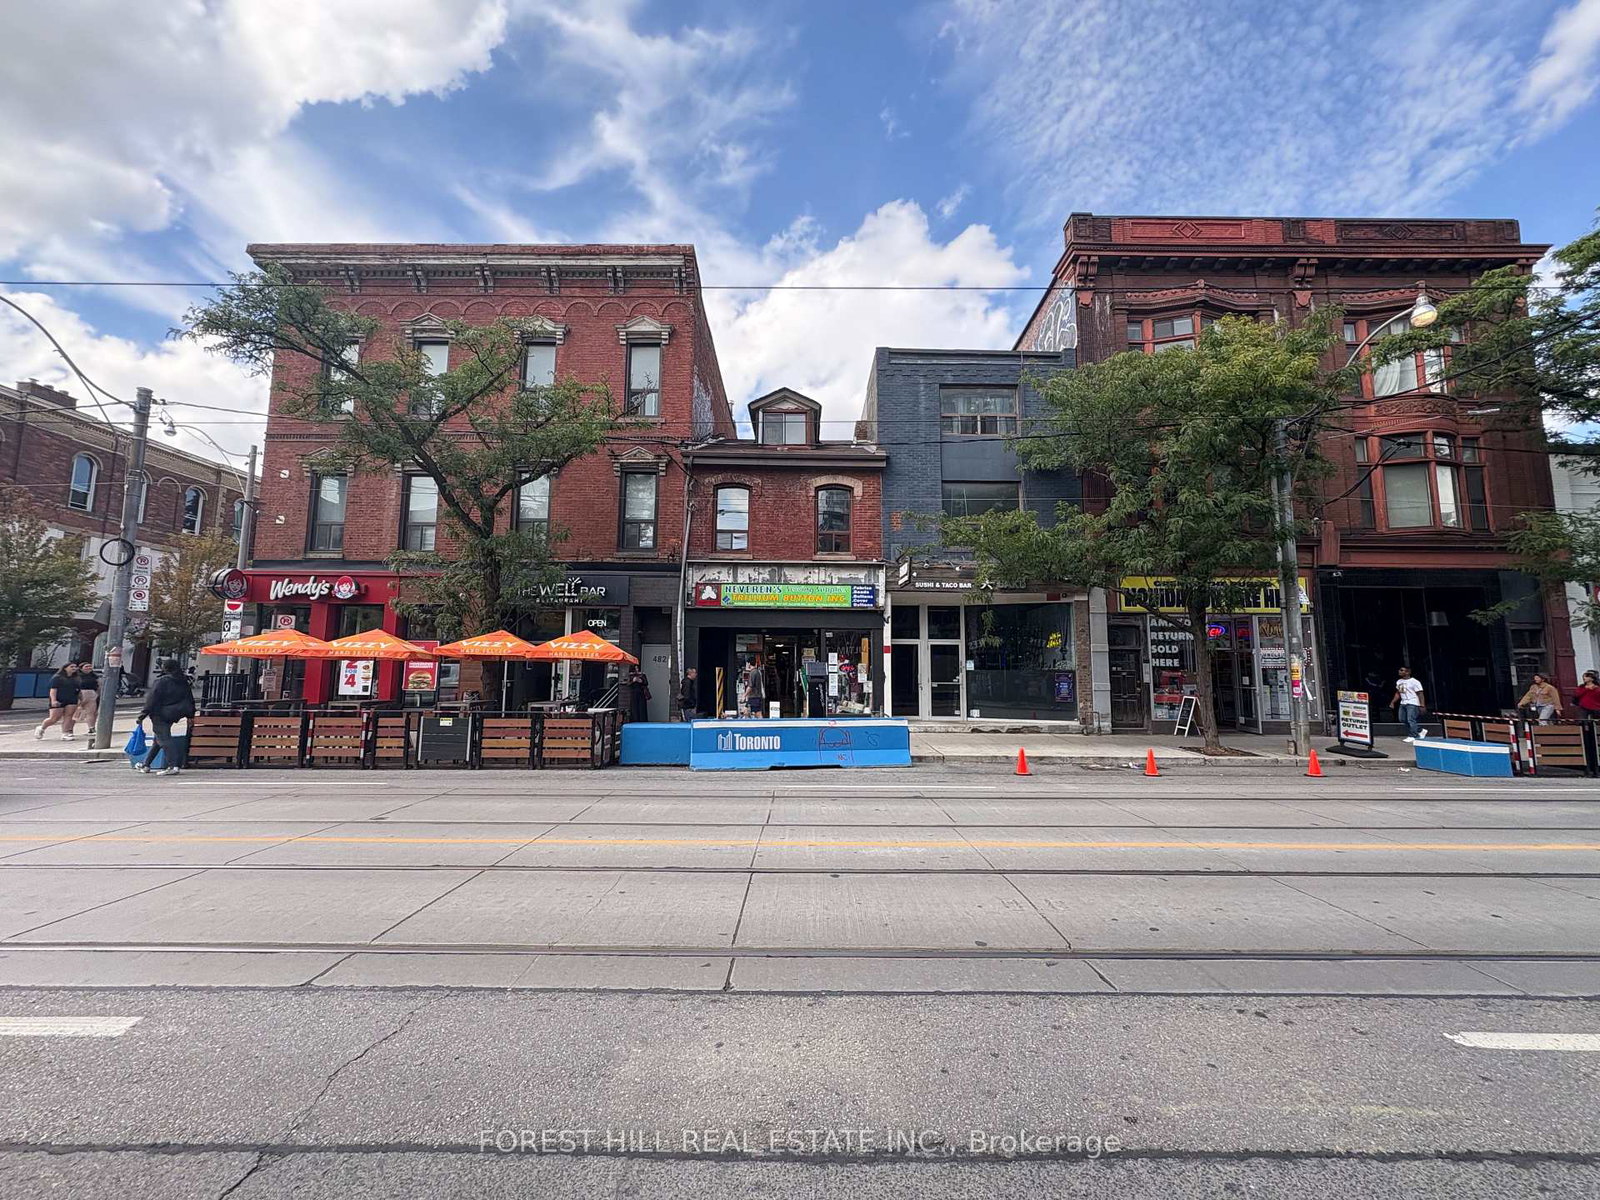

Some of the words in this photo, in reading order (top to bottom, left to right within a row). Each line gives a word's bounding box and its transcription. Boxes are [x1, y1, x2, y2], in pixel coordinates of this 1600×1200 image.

[270, 575, 331, 600] Wendy's
[539, 582, 577, 597] WELL
[725, 585, 782, 593] NEVEREN'S
[588, 619, 607, 627] OPEN
[549, 641, 606, 650] VIZZY
[1151, 645, 1179, 653] SOLD
[652, 655, 667, 663] 482
[1152, 658, 1180, 667] HERE
[1342, 722, 1368, 730] OUTLET
[733, 733, 781, 750] TORONTO
